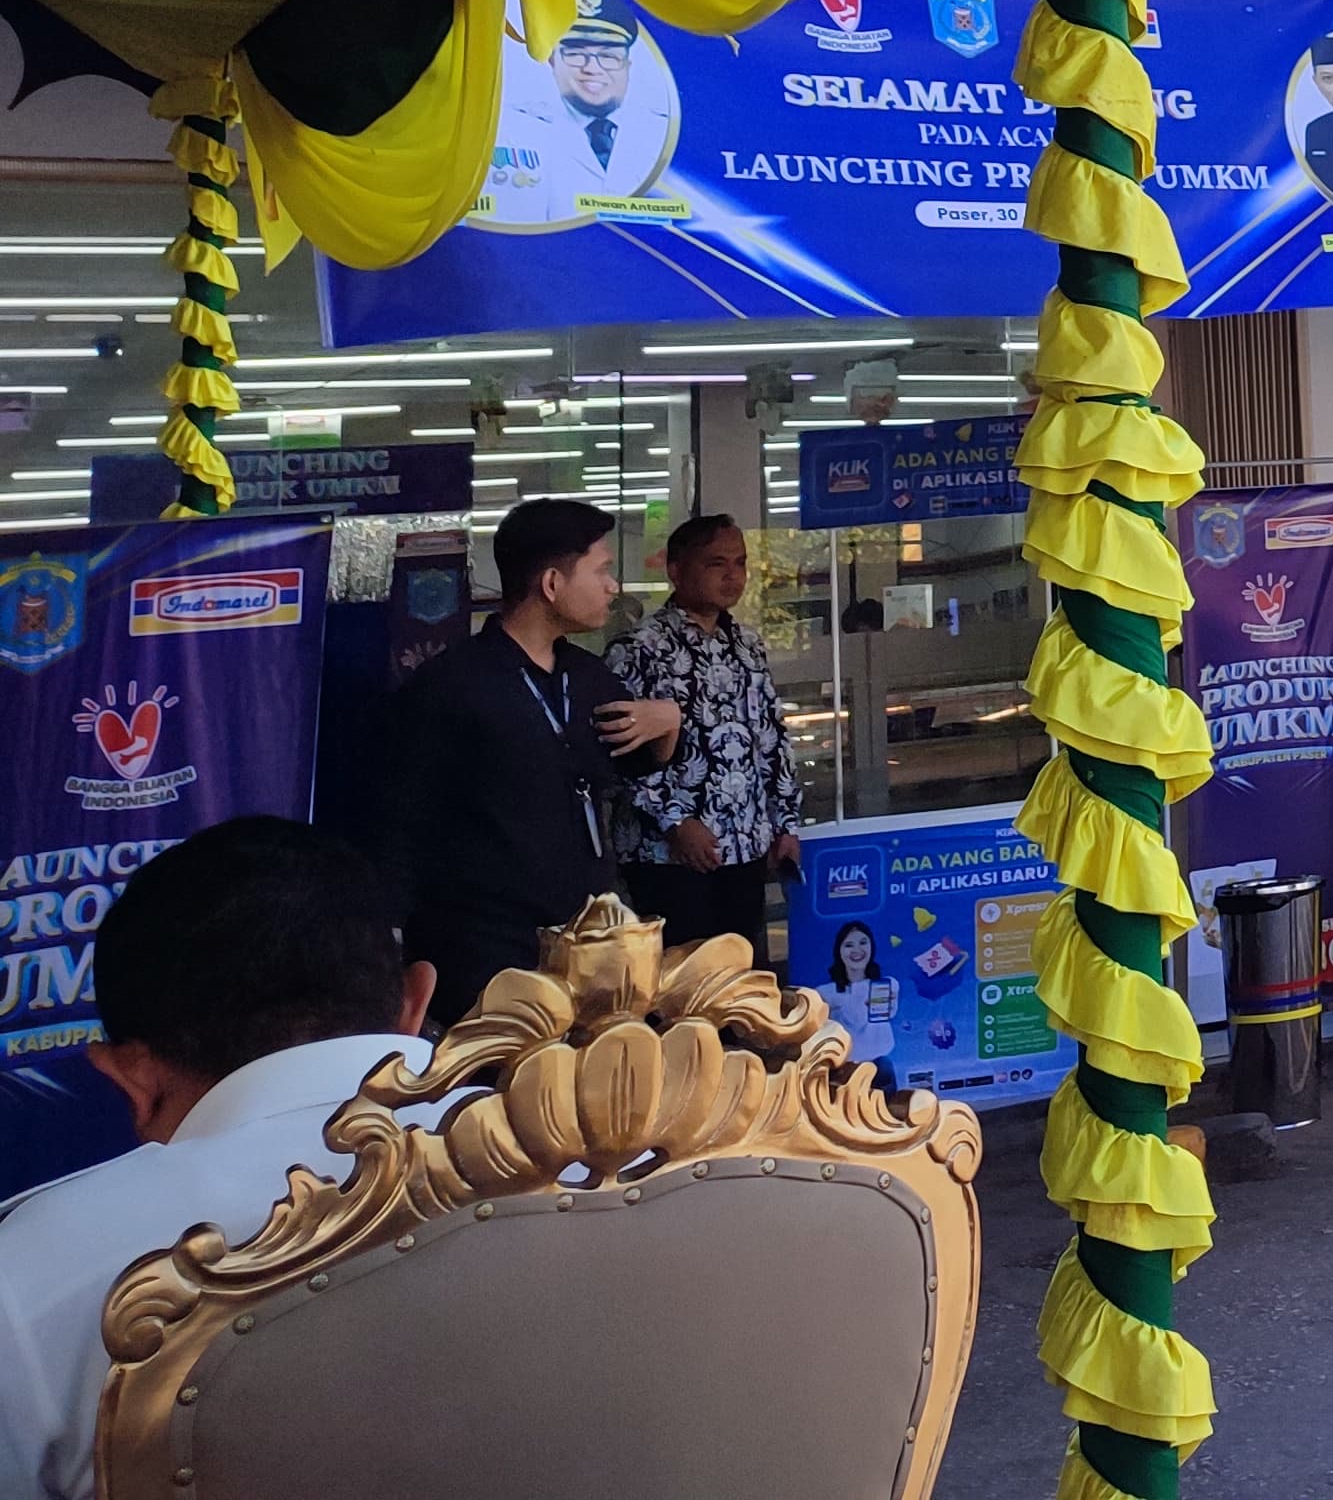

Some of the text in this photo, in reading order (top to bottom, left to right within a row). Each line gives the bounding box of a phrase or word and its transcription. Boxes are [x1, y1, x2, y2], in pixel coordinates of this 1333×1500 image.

[783, 73, 1007, 115] SELAMAT
[919, 123, 990, 147] PADA
[722, 150, 973, 188] LAUNCHING
[1155, 164, 1269, 190] UMKM
[630, 201, 685, 213] Antasari
[938, 207, 1019, 223] Paser, 30
[893, 452, 937, 469] ADA
[943, 446, 999, 464] YANG
[893, 478, 909, 491] DI
[921, 471, 1003, 489] APLIKASI
[163, 591, 270, 614] Indomaret
[67, 770, 193, 793] BANGGA BUATAN
[84, 789, 176, 807] INDONESIA
[891, 857, 933, 874] ADA
[938, 847, 995, 868] YANG
[890, 865, 1049, 895] DI APLIKASI BARU
[7, 1026, 104, 1057] KABUPA
